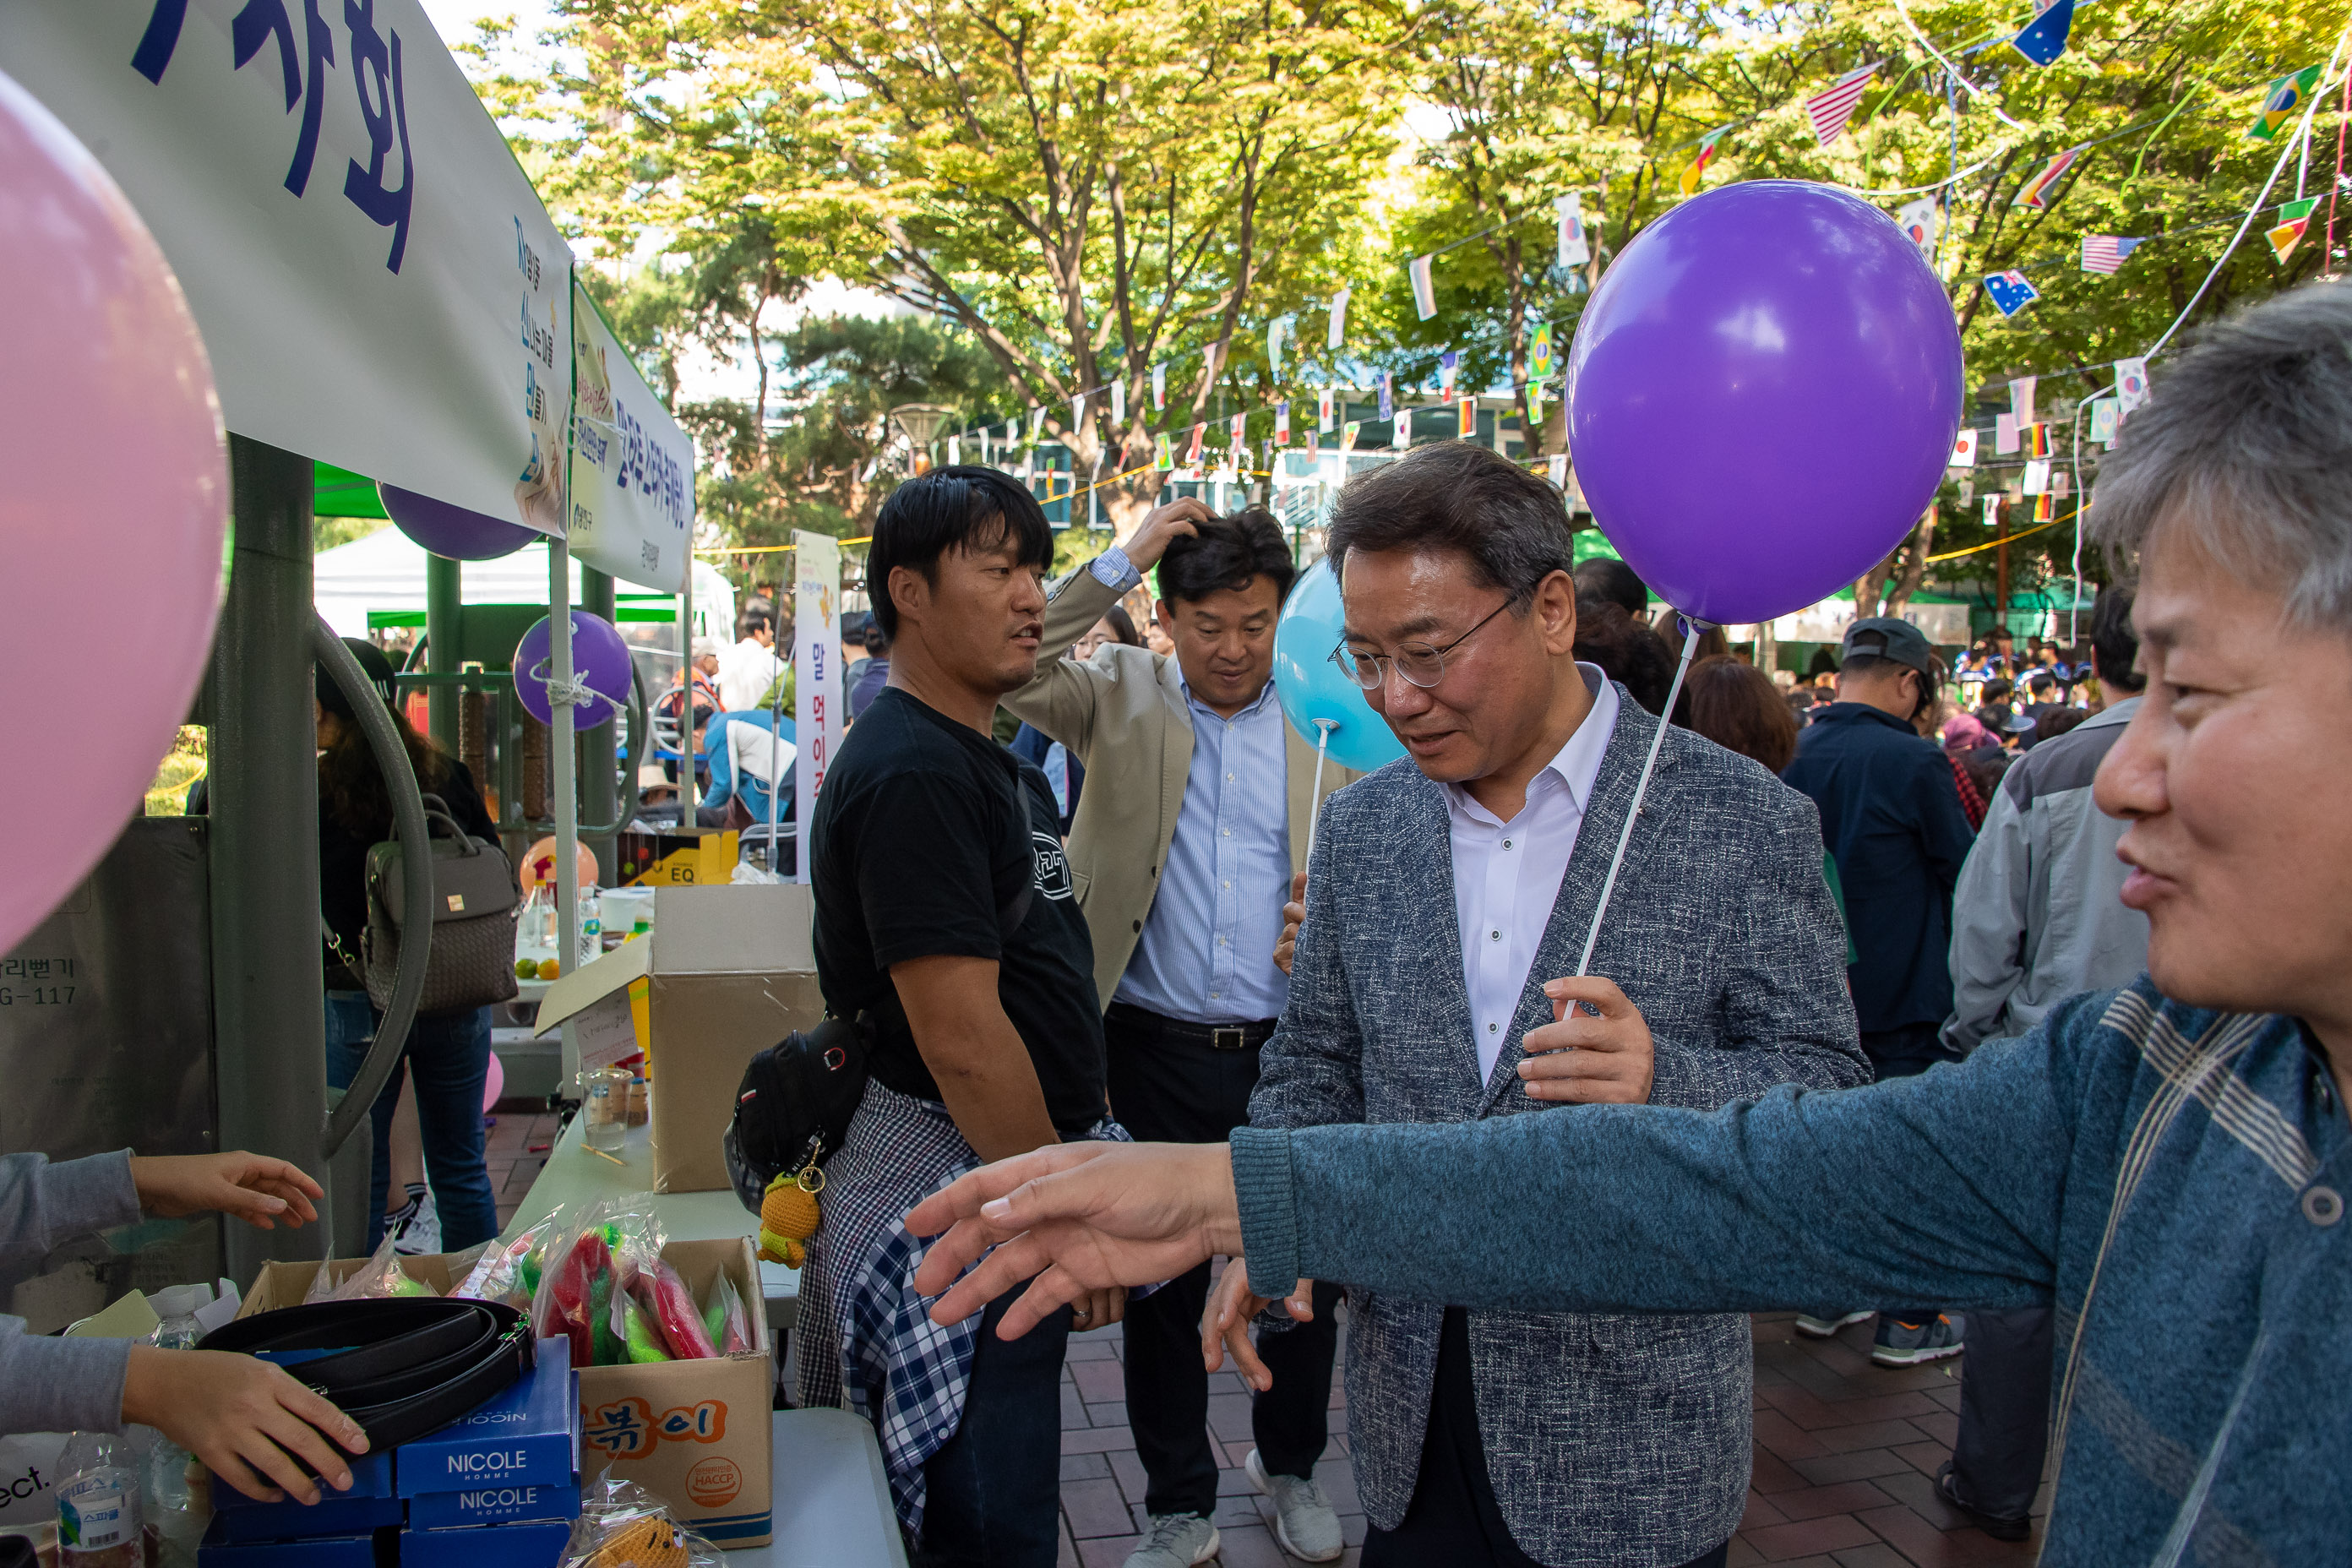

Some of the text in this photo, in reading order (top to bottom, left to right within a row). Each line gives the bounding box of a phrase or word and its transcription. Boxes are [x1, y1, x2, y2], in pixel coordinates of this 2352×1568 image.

[521, 291, 553, 368] 신나는 마을
[527, 362, 547, 425] 만들기
[813, 643, 825, 681] 말
[672, 867, 694, 884] EQ
[0, 958, 74, 979] 리뻗기
[580, 1405, 709, 1451] 볶이
[448, 1450, 527, 1473] NICOLE
[465, 1472, 509, 1481] HOMME
[695, 1473, 734, 1486] HACCP
[460, 1487, 537, 1510] NICOLE
[476, 1506, 520, 1516] HOMME
